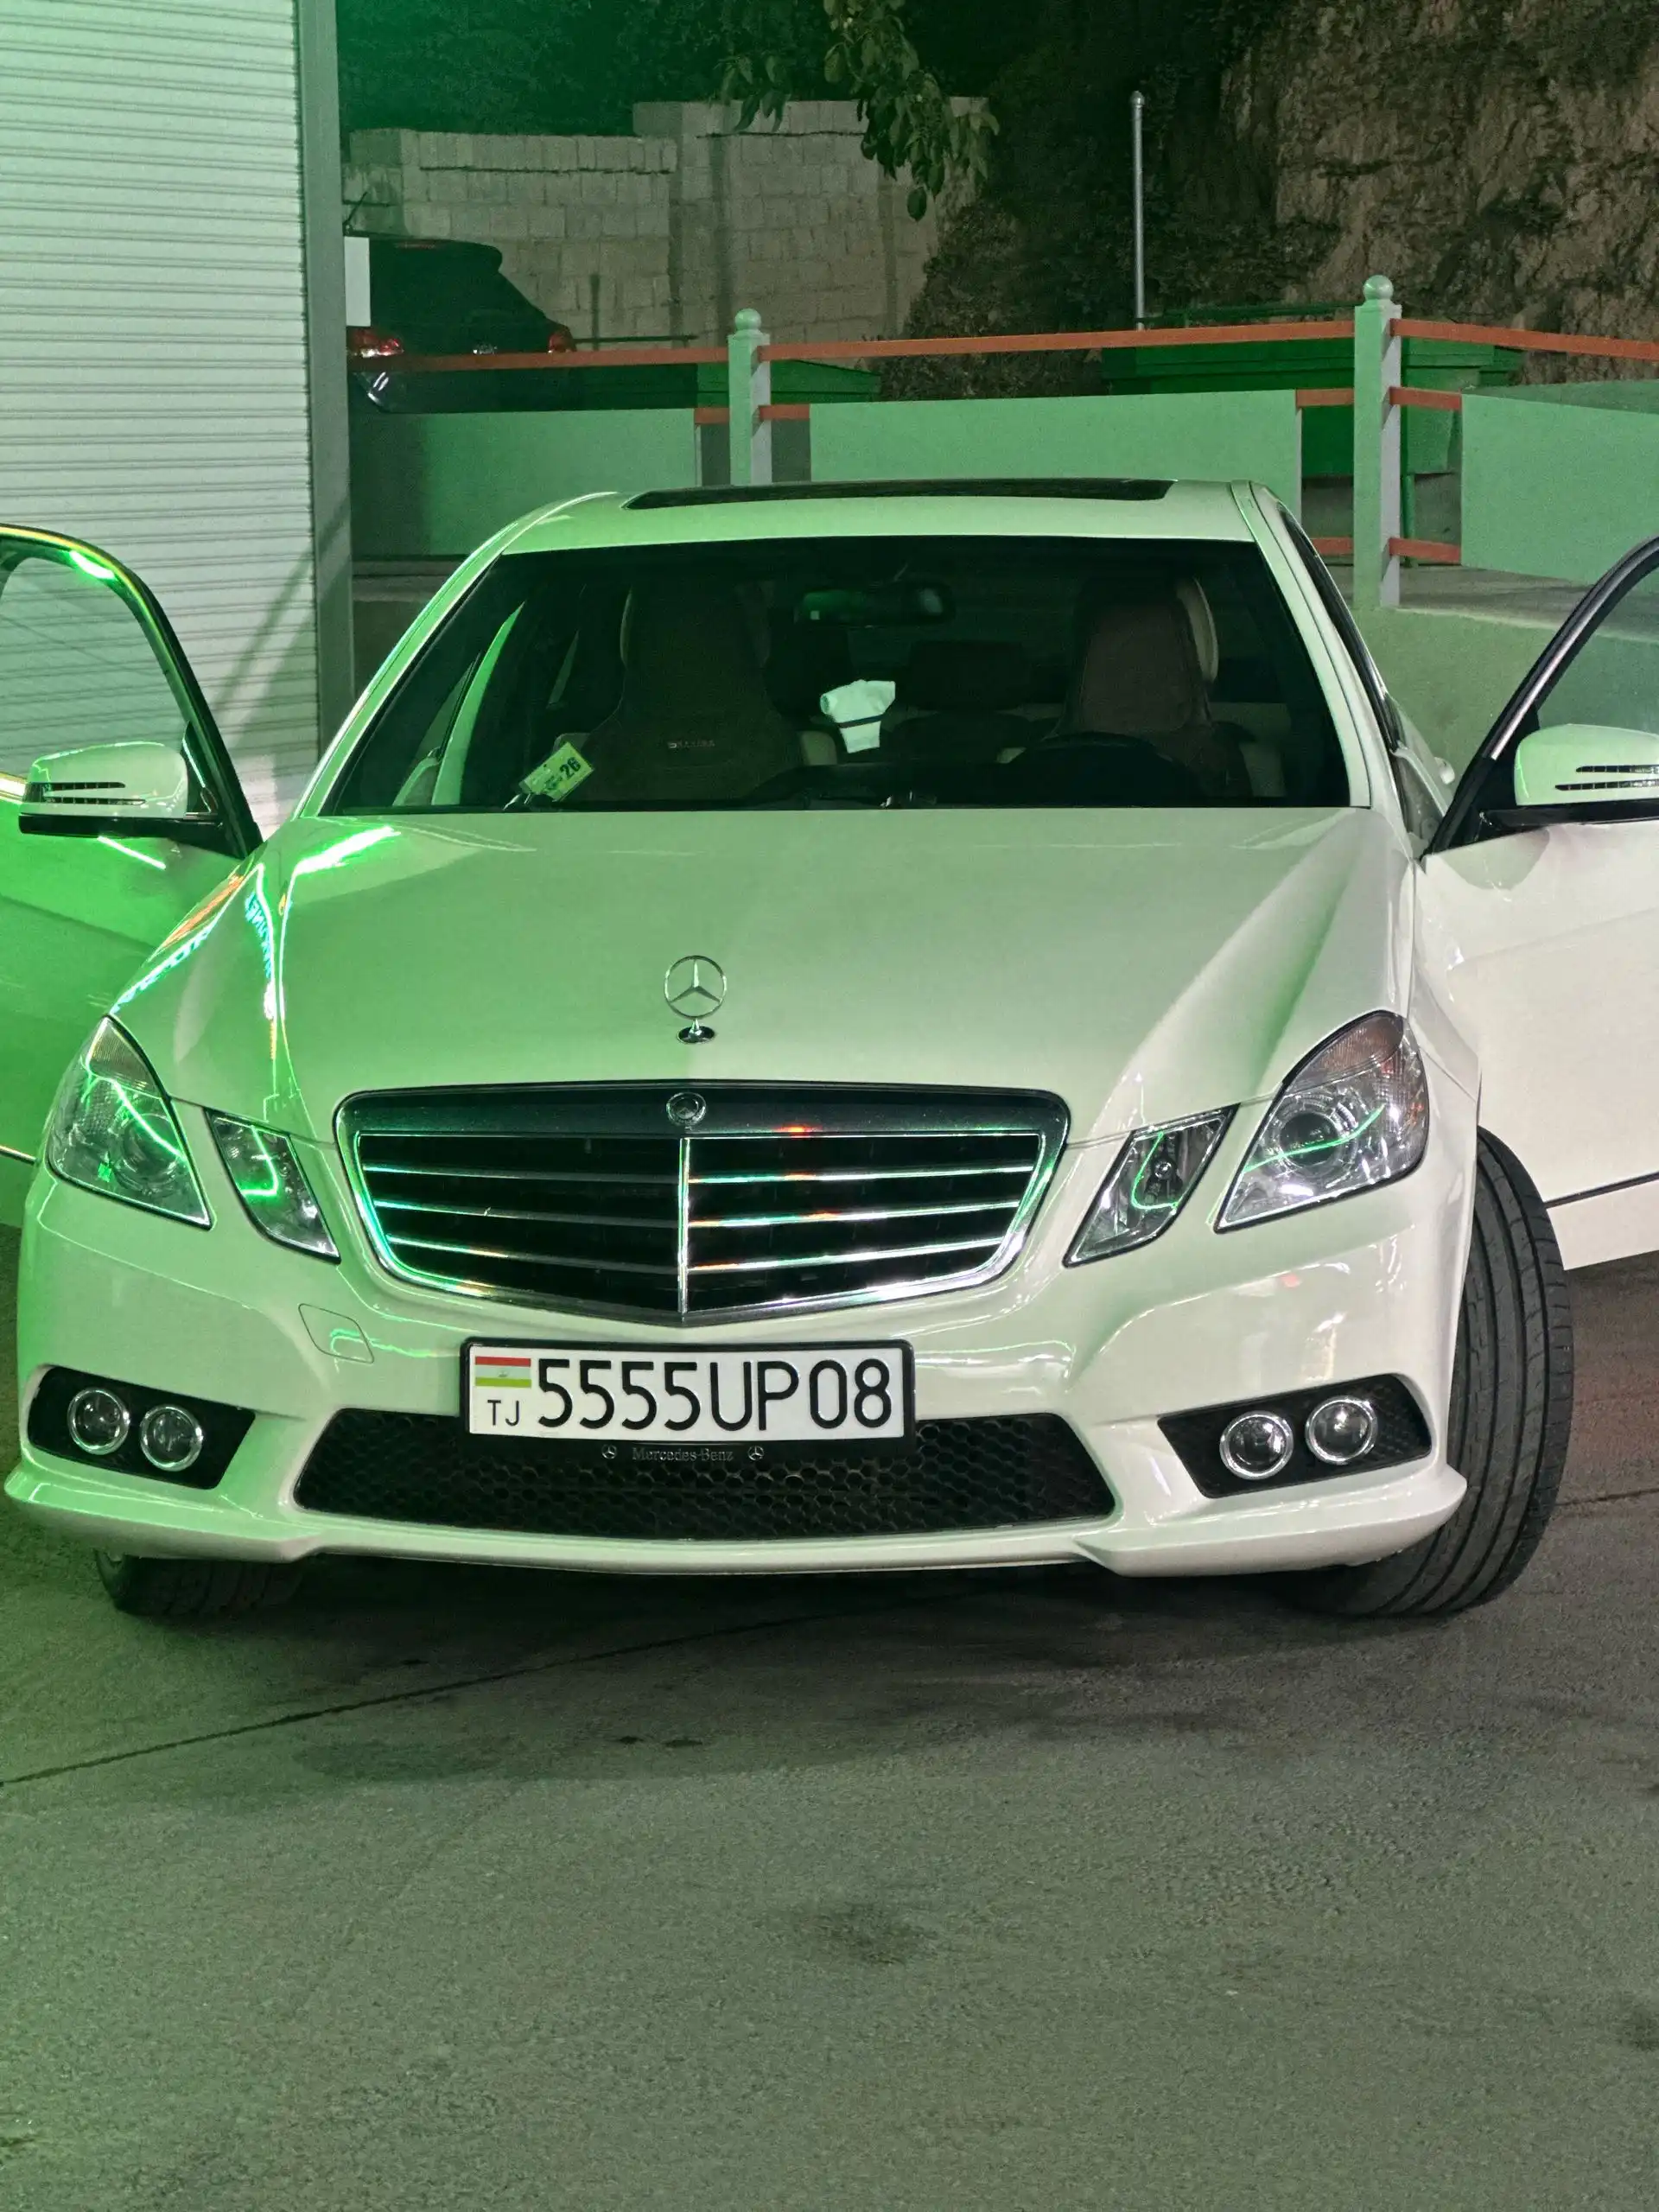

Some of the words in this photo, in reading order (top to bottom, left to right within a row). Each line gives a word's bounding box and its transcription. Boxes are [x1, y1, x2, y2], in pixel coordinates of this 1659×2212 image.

[537, 1357, 892, 1431] 5555UP08
[486, 1399, 520, 1427] TJ
[632, 1447, 734, 1462] Mercedes-Benz
